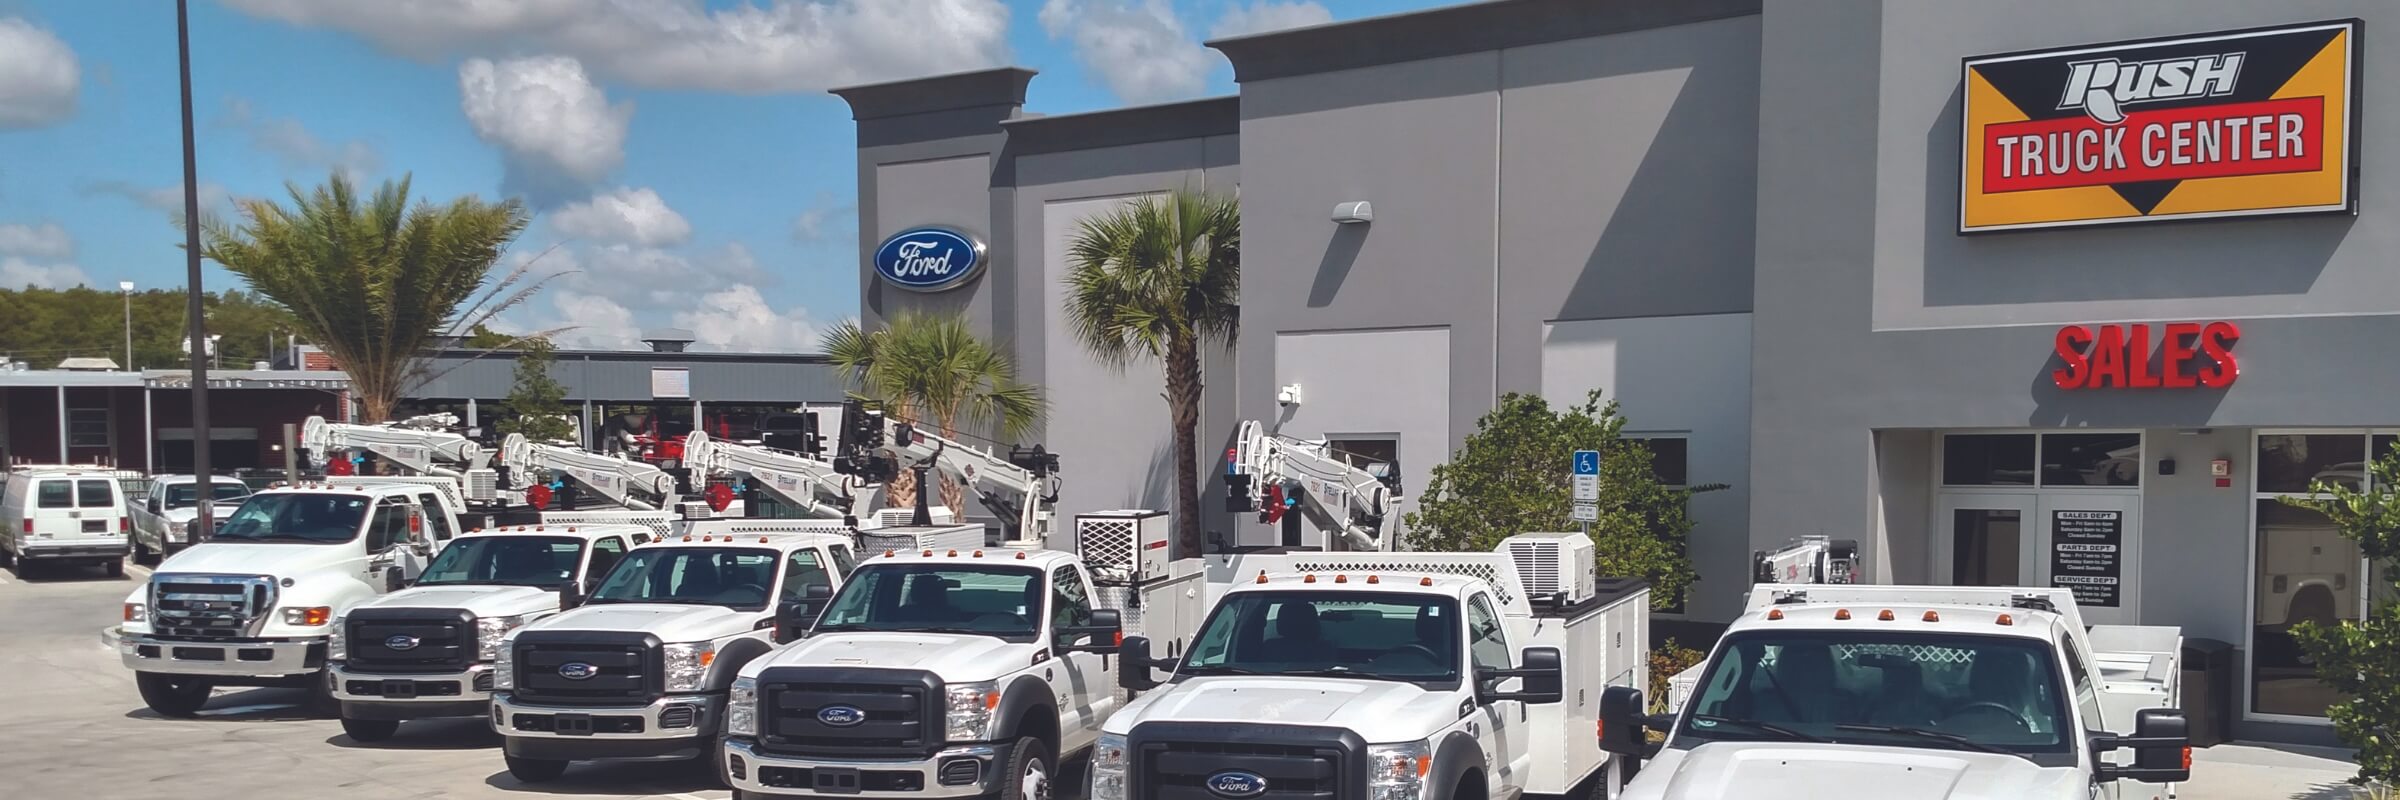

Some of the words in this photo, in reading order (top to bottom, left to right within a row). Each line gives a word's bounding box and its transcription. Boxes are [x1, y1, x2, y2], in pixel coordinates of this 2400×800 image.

[2056, 51, 2247, 125] RUSH
[1997, 126, 2127, 179] TRUCK
[2141, 113, 2306, 169] CENTER
[893, 241, 953, 278] Ford
[2052, 321, 2241, 390] SALES
[826, 710, 852, 721] Ford
[1218, 776, 1251, 791] Ford
